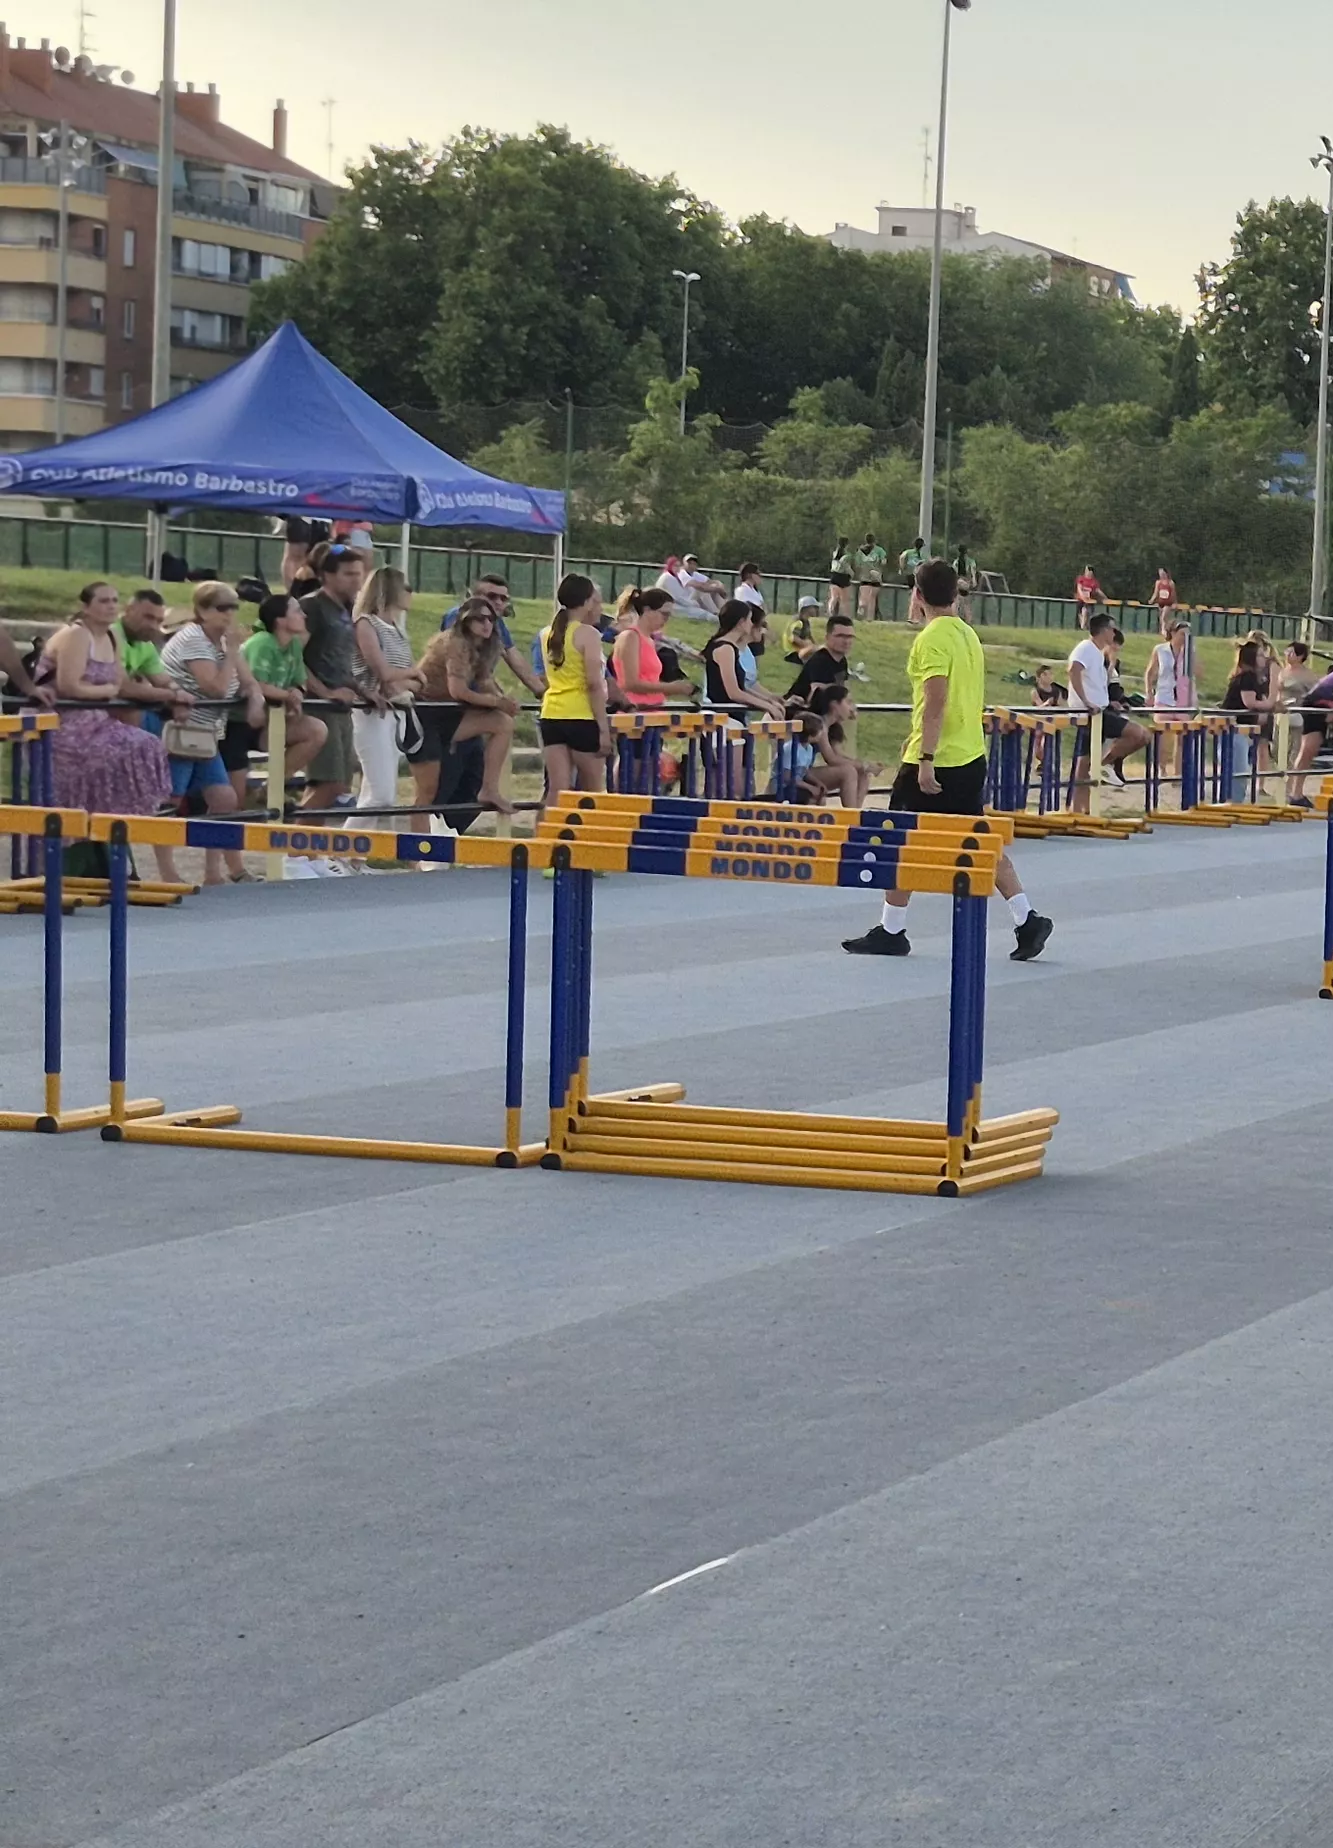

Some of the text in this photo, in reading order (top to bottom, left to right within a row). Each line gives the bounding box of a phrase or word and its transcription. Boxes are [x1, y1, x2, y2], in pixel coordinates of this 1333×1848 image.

[82, 466, 188, 486] Atletismo
[195, 472, 299, 497] Barbastro
[269, 830, 371, 853] MONDO
[711, 856, 812, 880] MONDO
